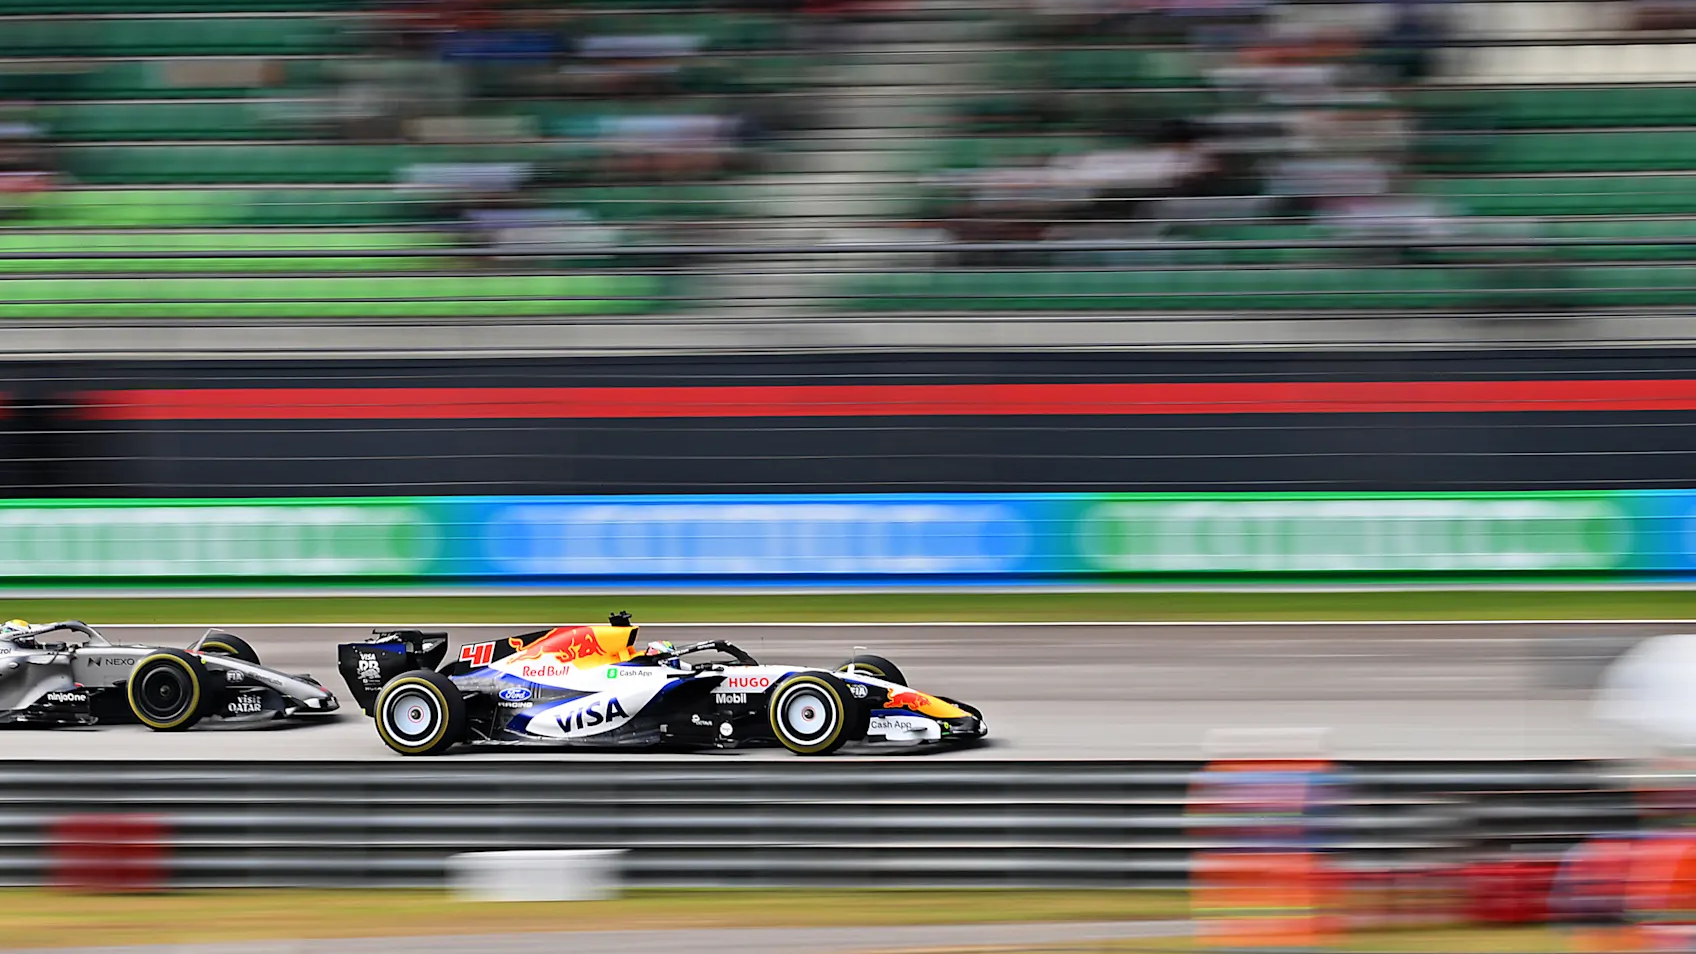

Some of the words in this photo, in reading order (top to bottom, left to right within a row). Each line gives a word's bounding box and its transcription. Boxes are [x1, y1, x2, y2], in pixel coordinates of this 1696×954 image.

[359, 651, 376, 660] VISA
[459, 641, 496, 668] 41
[105, 658, 135, 666] NEXO
[227, 671, 243, 681] FIA
[522, 665, 545, 677] Red
[547, 665, 570, 677] Bull
[619, 669, 637, 677] Cash
[638, 670, 653, 678] App
[729, 677, 769, 688] HUGO
[849, 685, 867, 697] FIA
[47, 692, 86, 703] ninjaOne
[237, 694, 261, 704] visit
[715, 693, 747, 704] Mobil
[228, 702, 261, 713] QATAR
[554, 696, 630, 734] VISA
[870, 720, 893, 729] Cash
[894, 721, 912, 730] App
